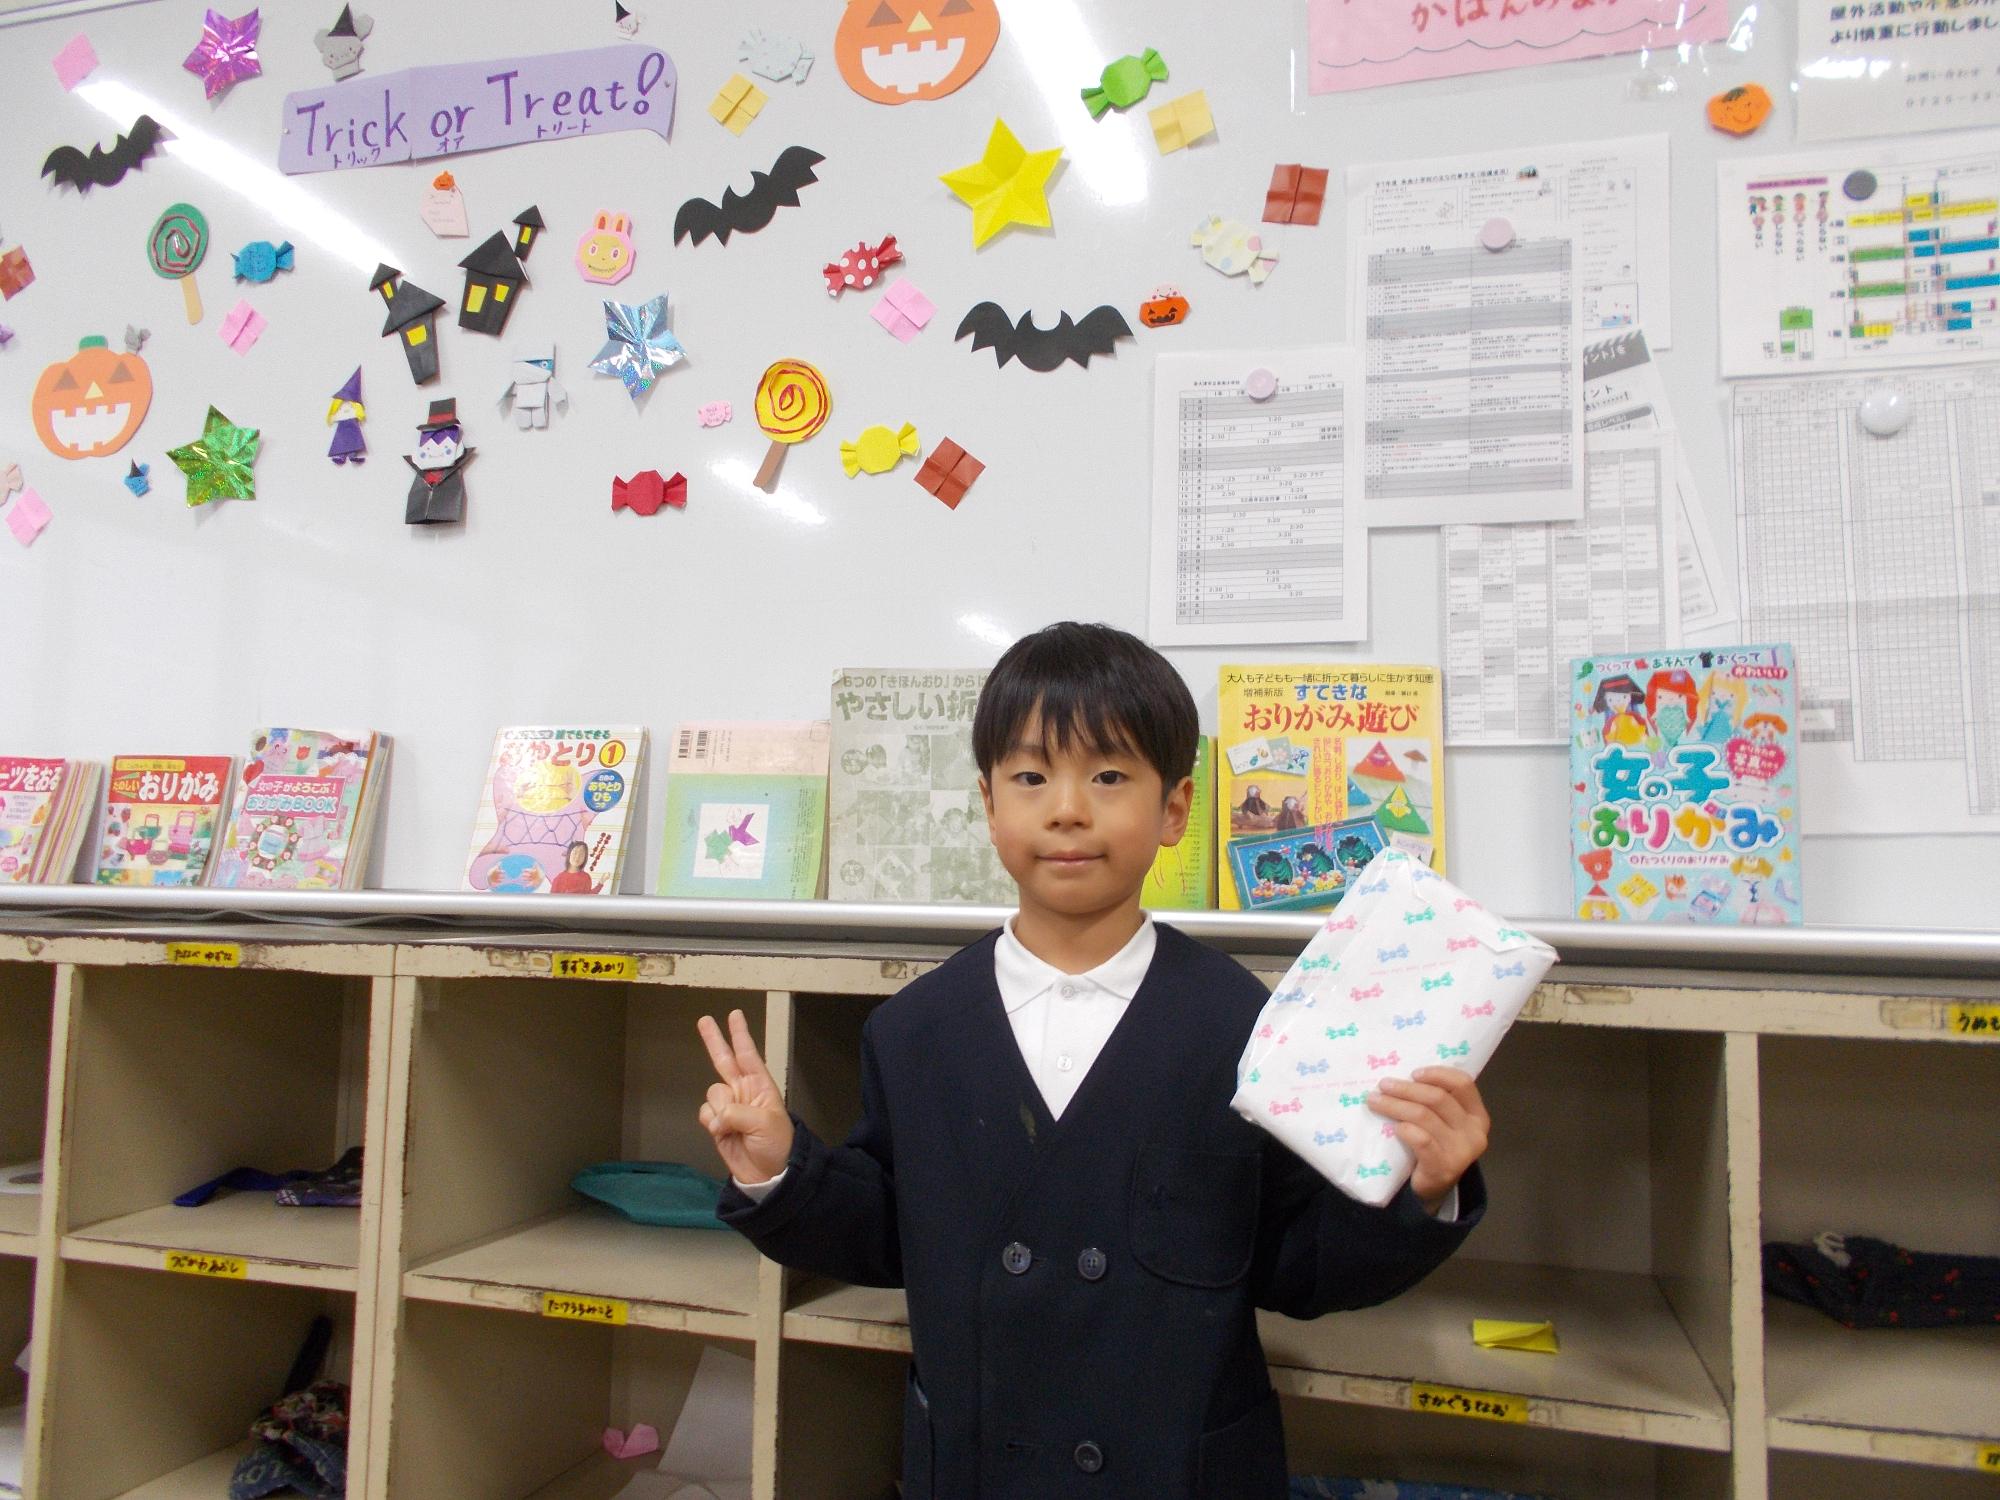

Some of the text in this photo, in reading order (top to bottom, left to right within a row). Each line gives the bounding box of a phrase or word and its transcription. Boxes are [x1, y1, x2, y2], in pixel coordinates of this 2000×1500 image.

[1411, 0, 1618, 32] かばん
[297, 53, 666, 156] Trick or Treat!
[536, 119, 592, 139] トリート
[438, 137, 465, 153] オア
[332, 148, 381, 168] トリック
[1596, 661, 1631, 672] つくって
[1652, 656, 1697, 669] あそんで
[1716, 652, 1761, 665] おくって
[1227, 673, 1434, 684] 大人も子どもも一緒に折って暮らしに生かす知恵
[1243, 688, 1284, 697] 増補新版
[1294, 684, 1368, 701] すてきな
[1243, 702, 1420, 733] おりがみ遊び
[1594, 749, 1731, 801] 女の子
[139, 770, 219, 802] おりがみ
[257, 781, 337, 794] 女の子がよろこぶ!
[1593, 807, 1778, 849] おりがみ
